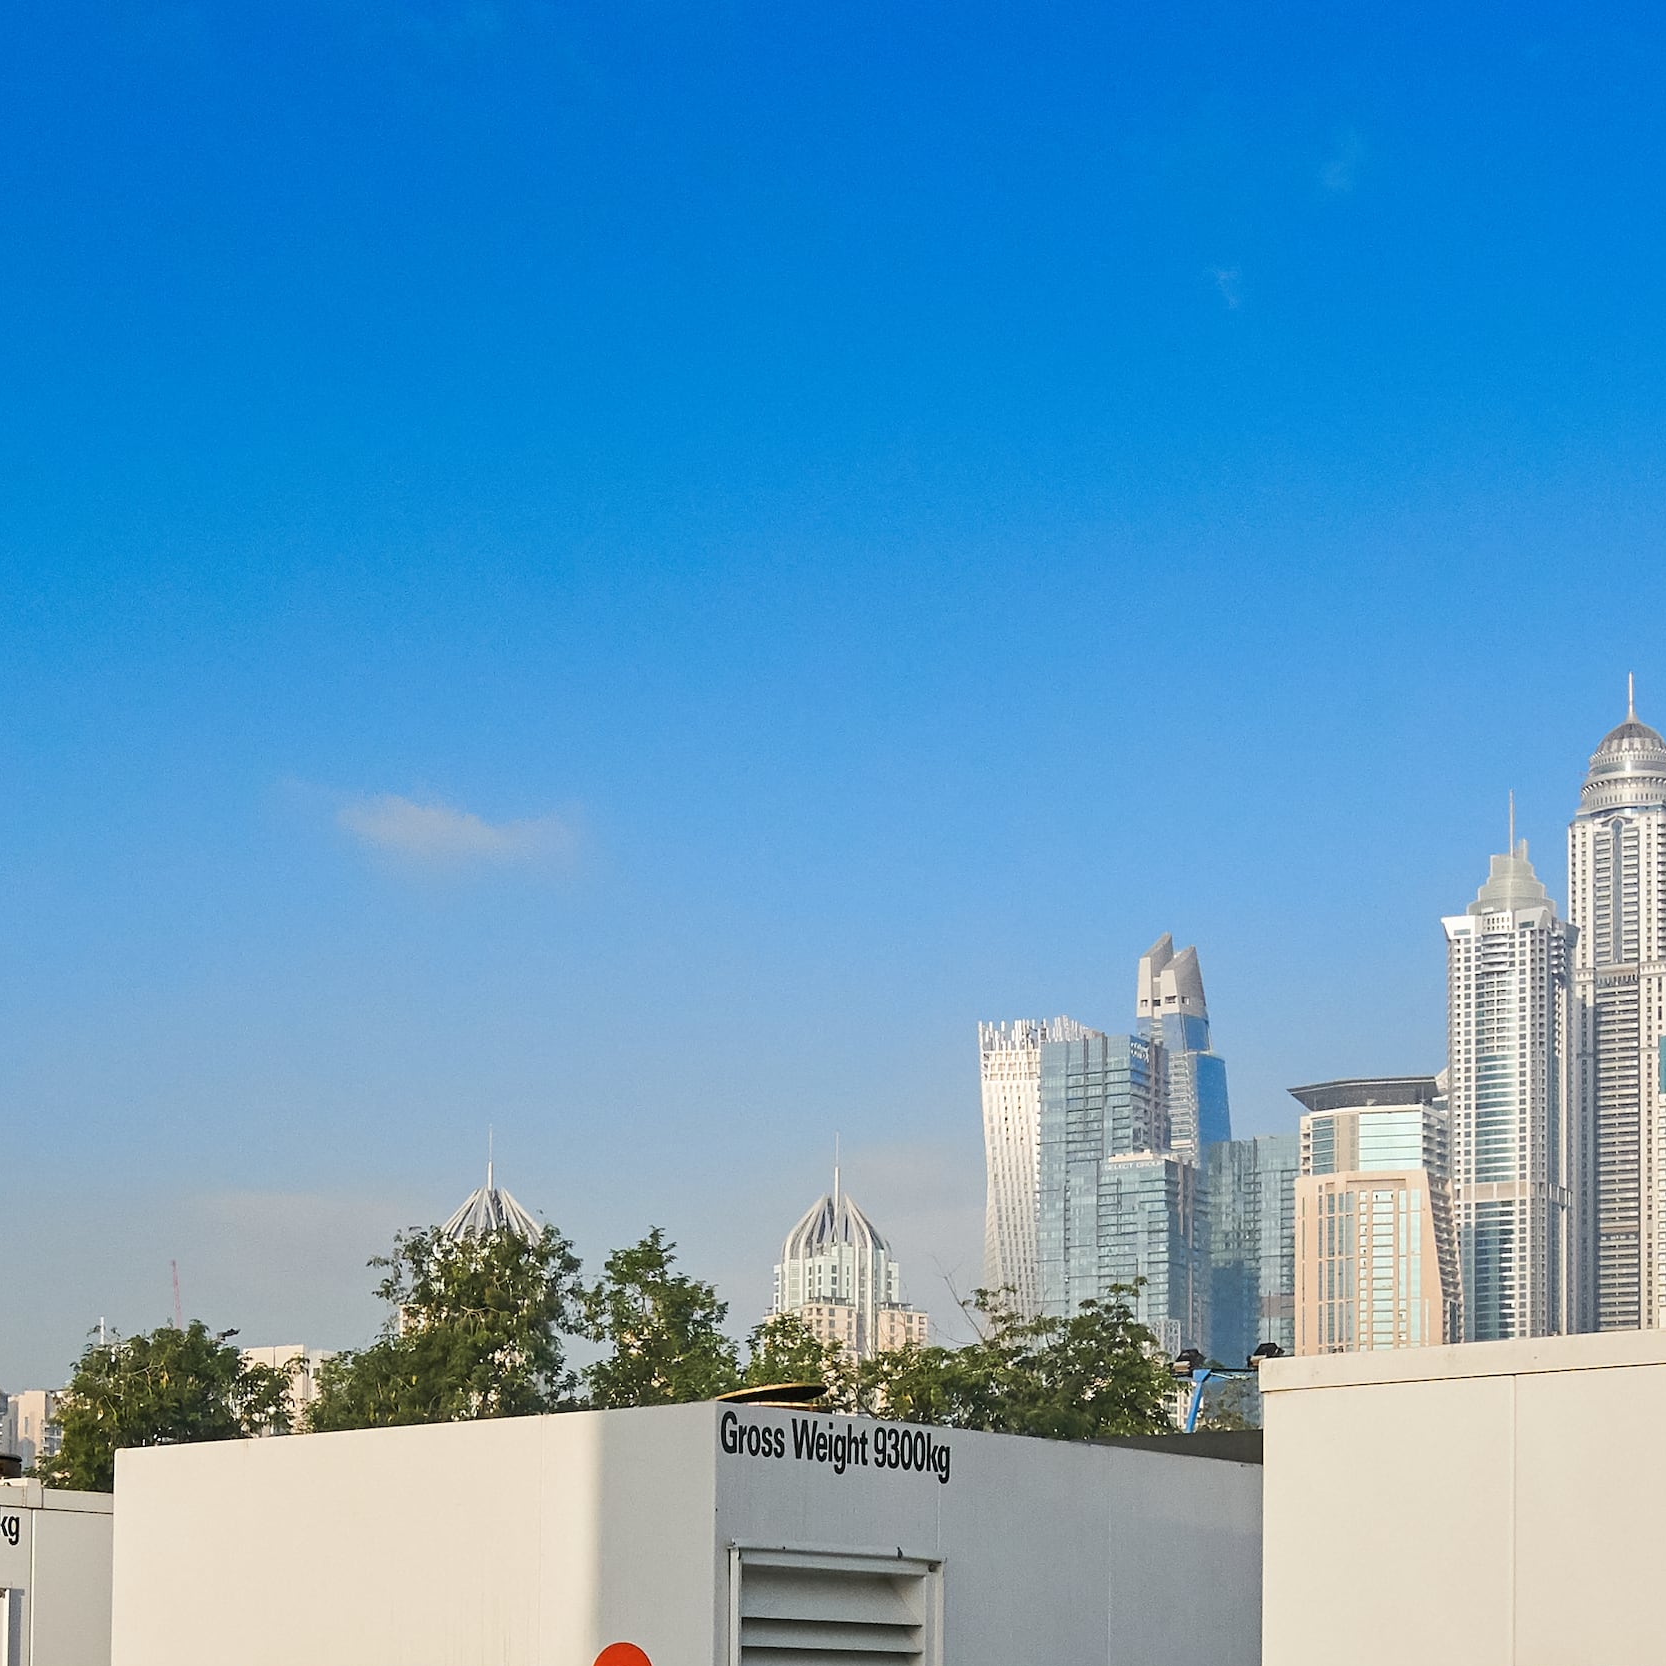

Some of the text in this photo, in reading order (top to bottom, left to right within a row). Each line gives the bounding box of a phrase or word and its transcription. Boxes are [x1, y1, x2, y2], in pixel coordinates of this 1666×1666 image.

[721, 1411, 950, 1484] Gross Weight 9300kg
